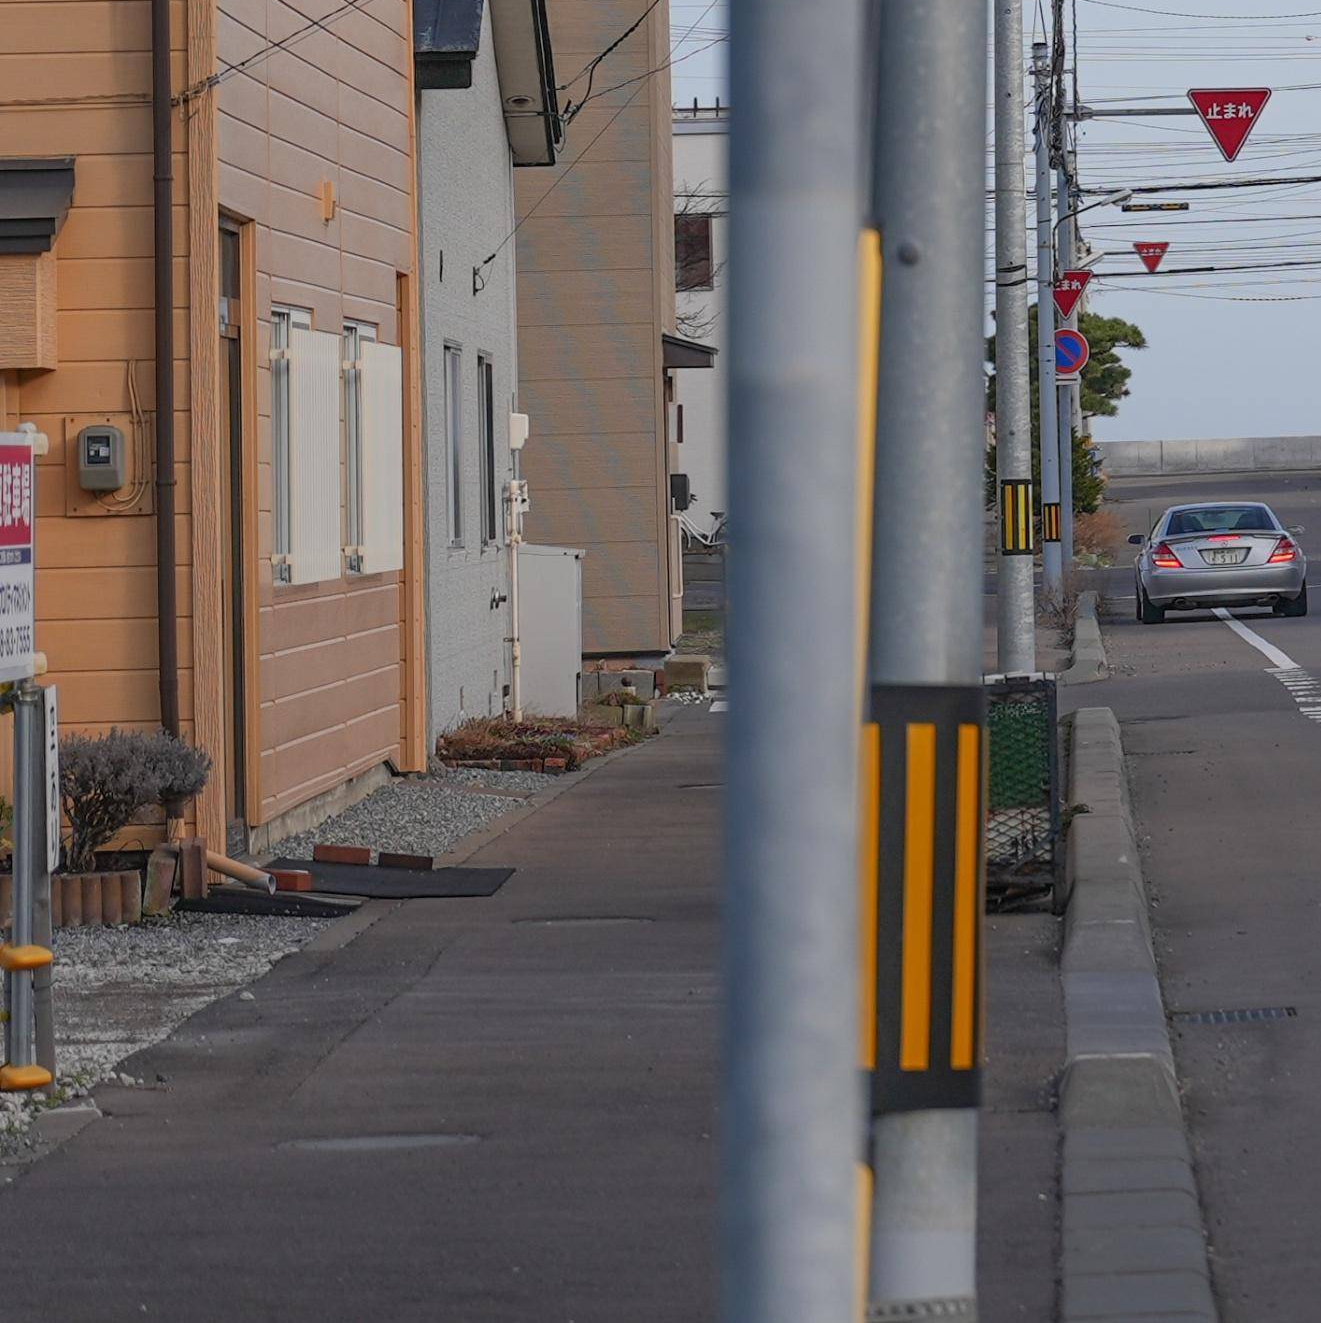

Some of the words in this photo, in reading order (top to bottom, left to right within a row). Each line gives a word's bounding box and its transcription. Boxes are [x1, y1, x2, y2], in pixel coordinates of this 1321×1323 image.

[1206, 102, 1254, 119] 止まれ
[0, 463, 30, 526] 駐車場
